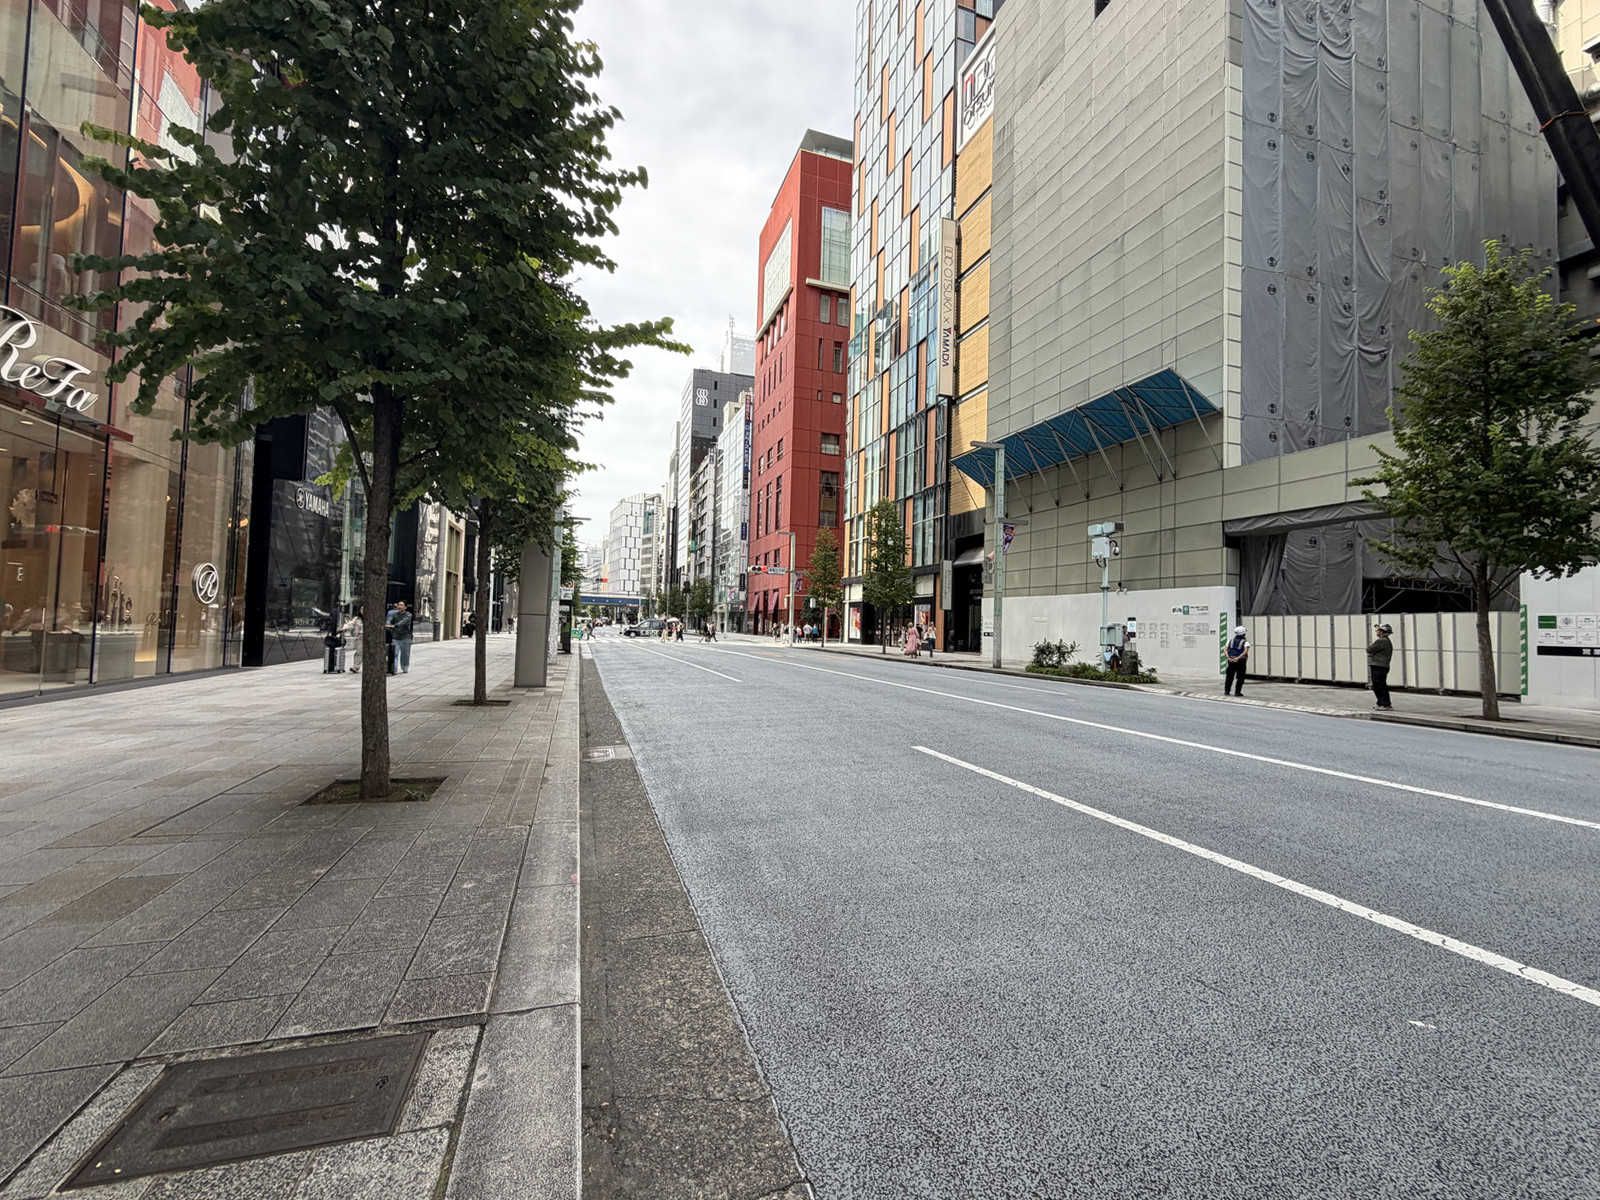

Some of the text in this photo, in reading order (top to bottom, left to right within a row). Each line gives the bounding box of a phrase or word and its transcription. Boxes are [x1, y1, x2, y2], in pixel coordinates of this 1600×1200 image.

[944, 245, 954, 267] IDC
[943, 267, 953, 313] OTSUKA
[0, 305, 99, 412] ReFa
[942, 326, 952, 367] YAMADA
[305, 491, 329, 519] YAMAHA
